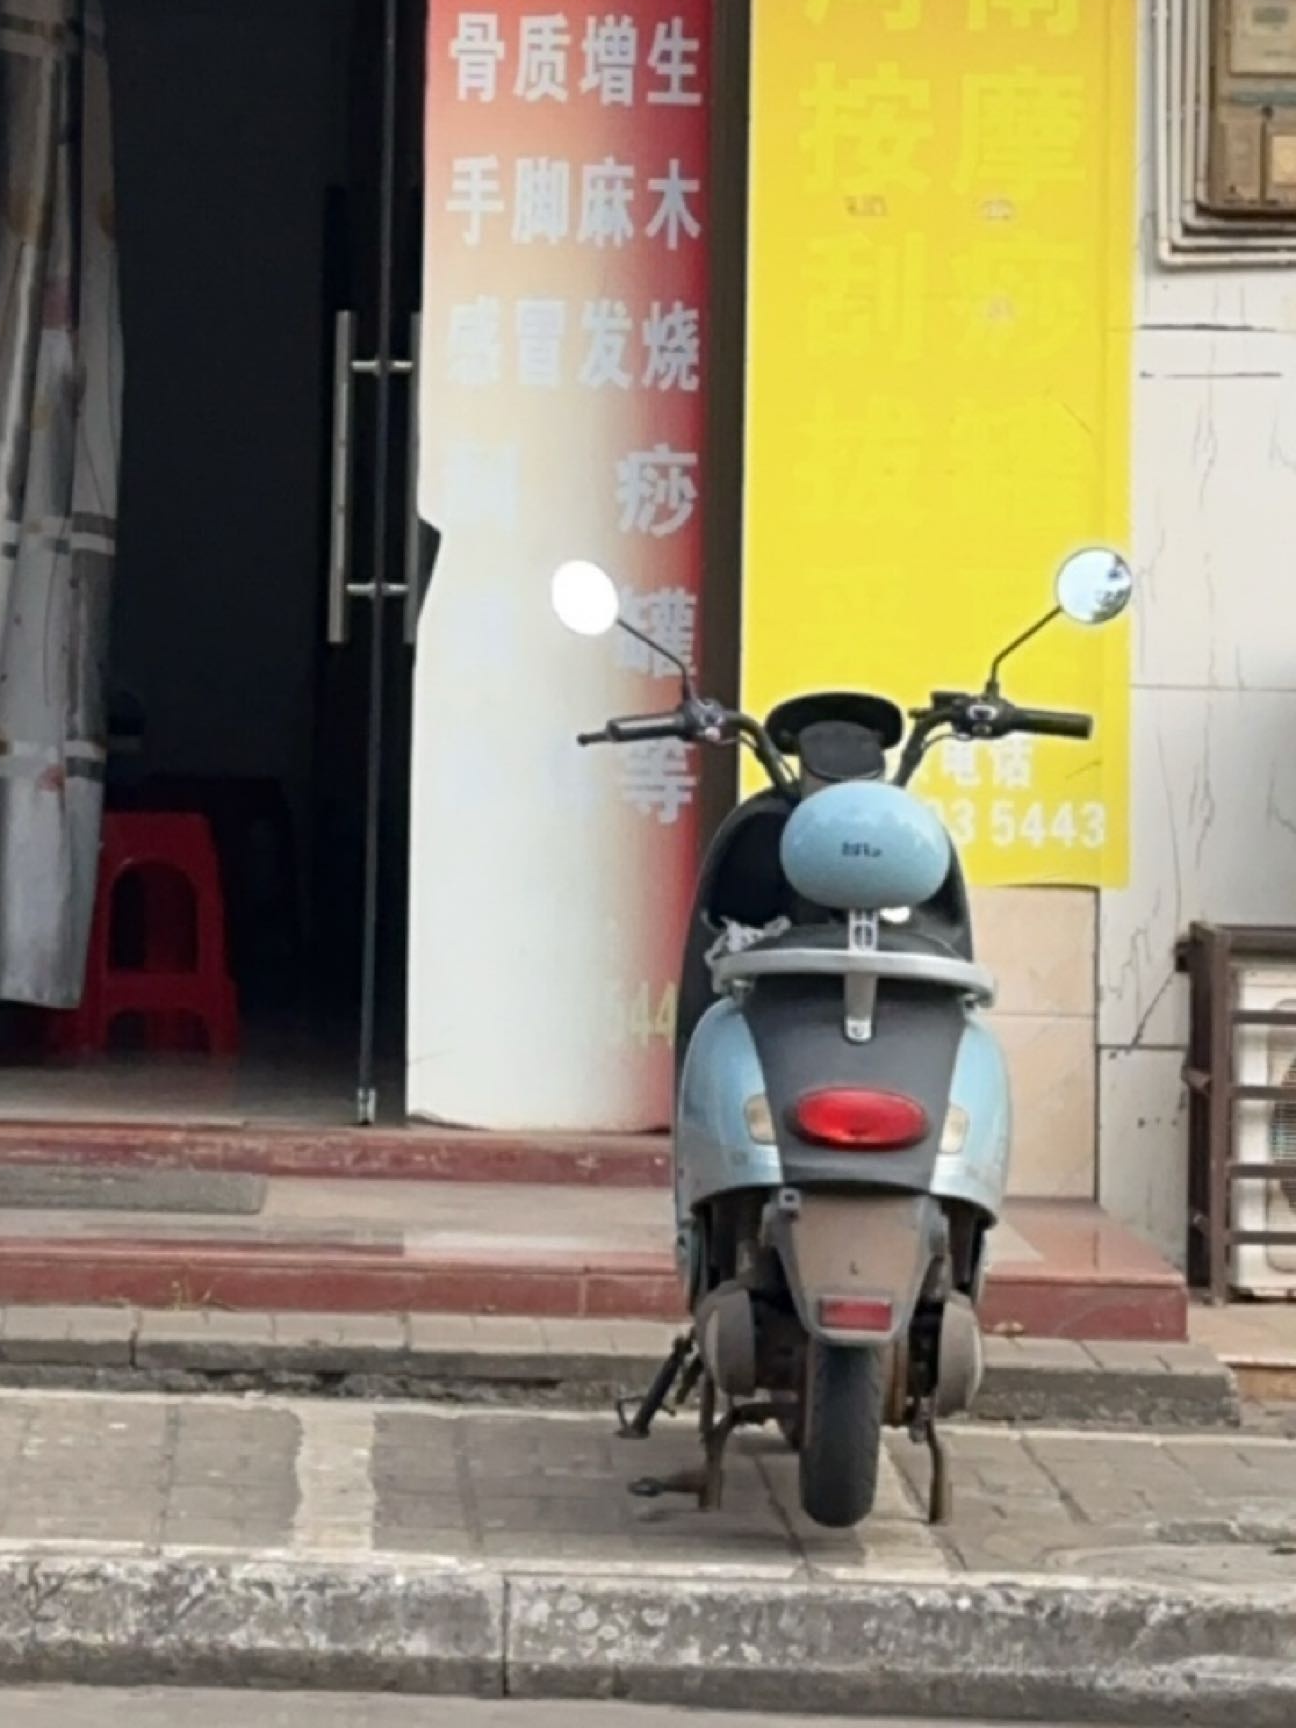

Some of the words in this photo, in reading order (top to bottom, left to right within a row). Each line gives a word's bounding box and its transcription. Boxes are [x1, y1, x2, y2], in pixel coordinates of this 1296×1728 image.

[449, 12, 702, 107] 骨质增生
[445, 155, 701, 249] 手脚麻木
